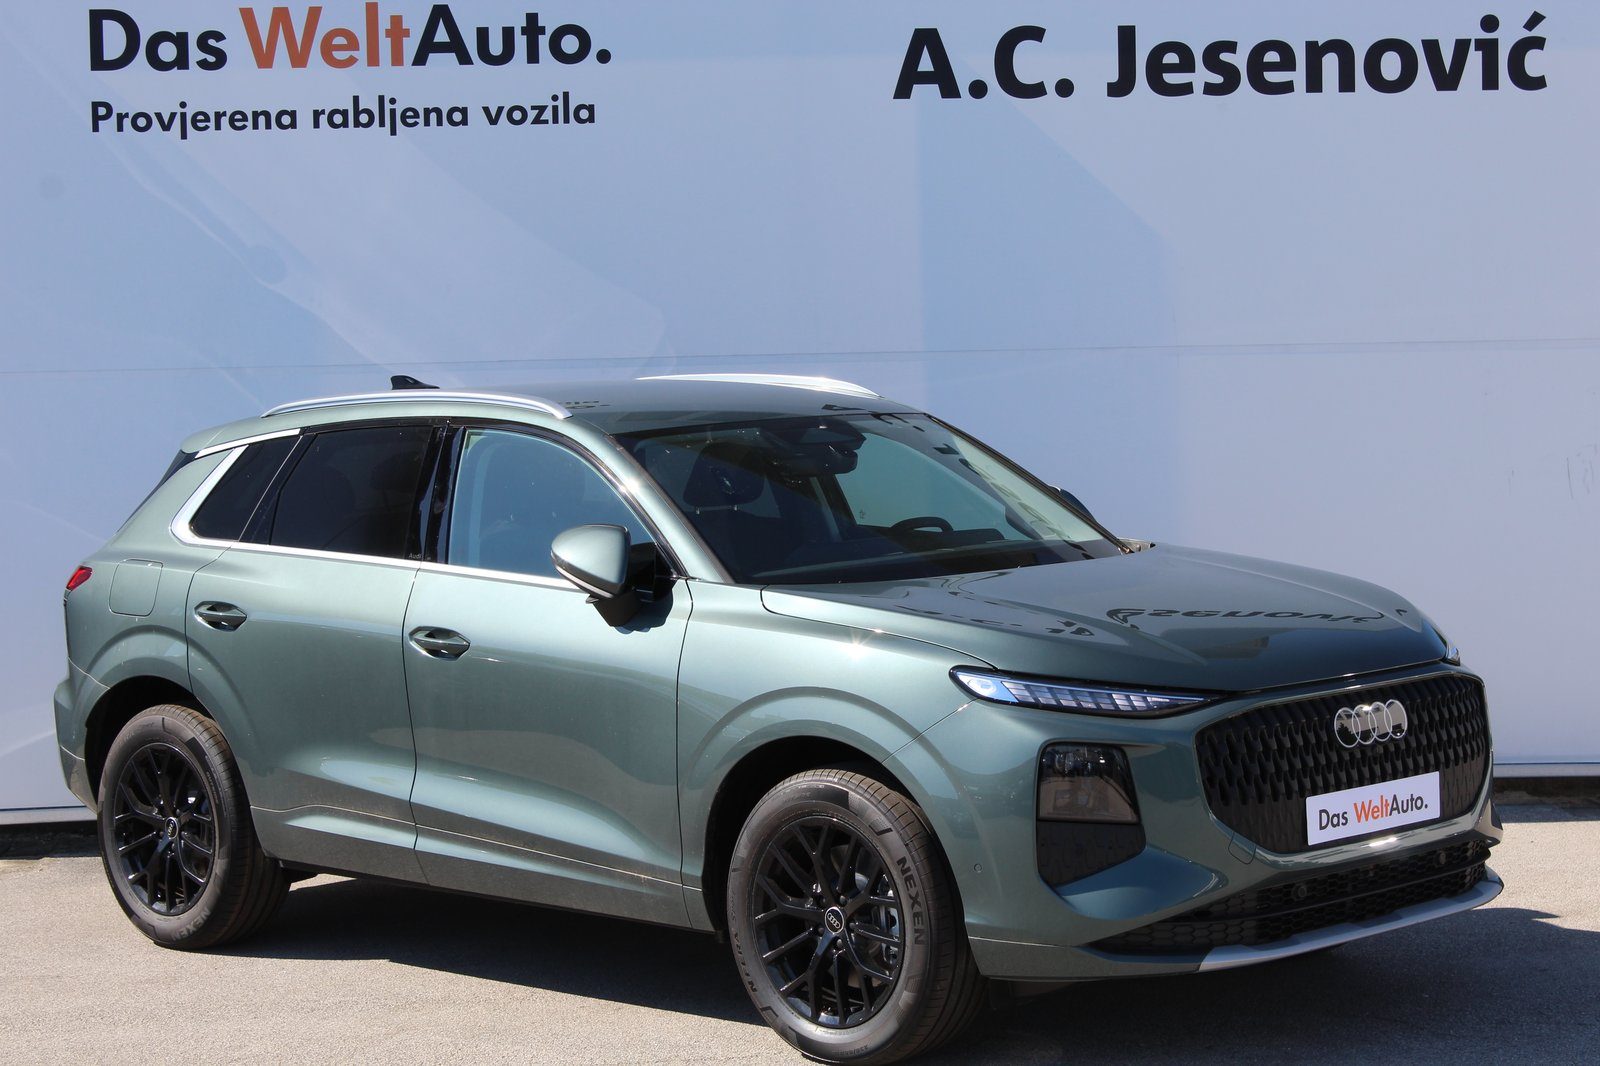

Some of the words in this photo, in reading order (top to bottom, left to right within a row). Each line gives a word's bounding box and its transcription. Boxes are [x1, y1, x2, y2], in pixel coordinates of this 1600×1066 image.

[89, 9, 228, 72] Das
[239, 2, 612, 69] WeltAuto.
[893, 25, 1075, 99] A.C.
[1107, 11, 1548, 98] Jesenović
[91, 101, 298, 140] Provjerena
[312, 95, 469, 136] rabljena
[482, 91, 596, 126] vozila
[1318, 809, 1348, 831] Das
[1353, 793, 1428, 824] WeltAuto.
[896, 856, 926, 945] NEXEN
